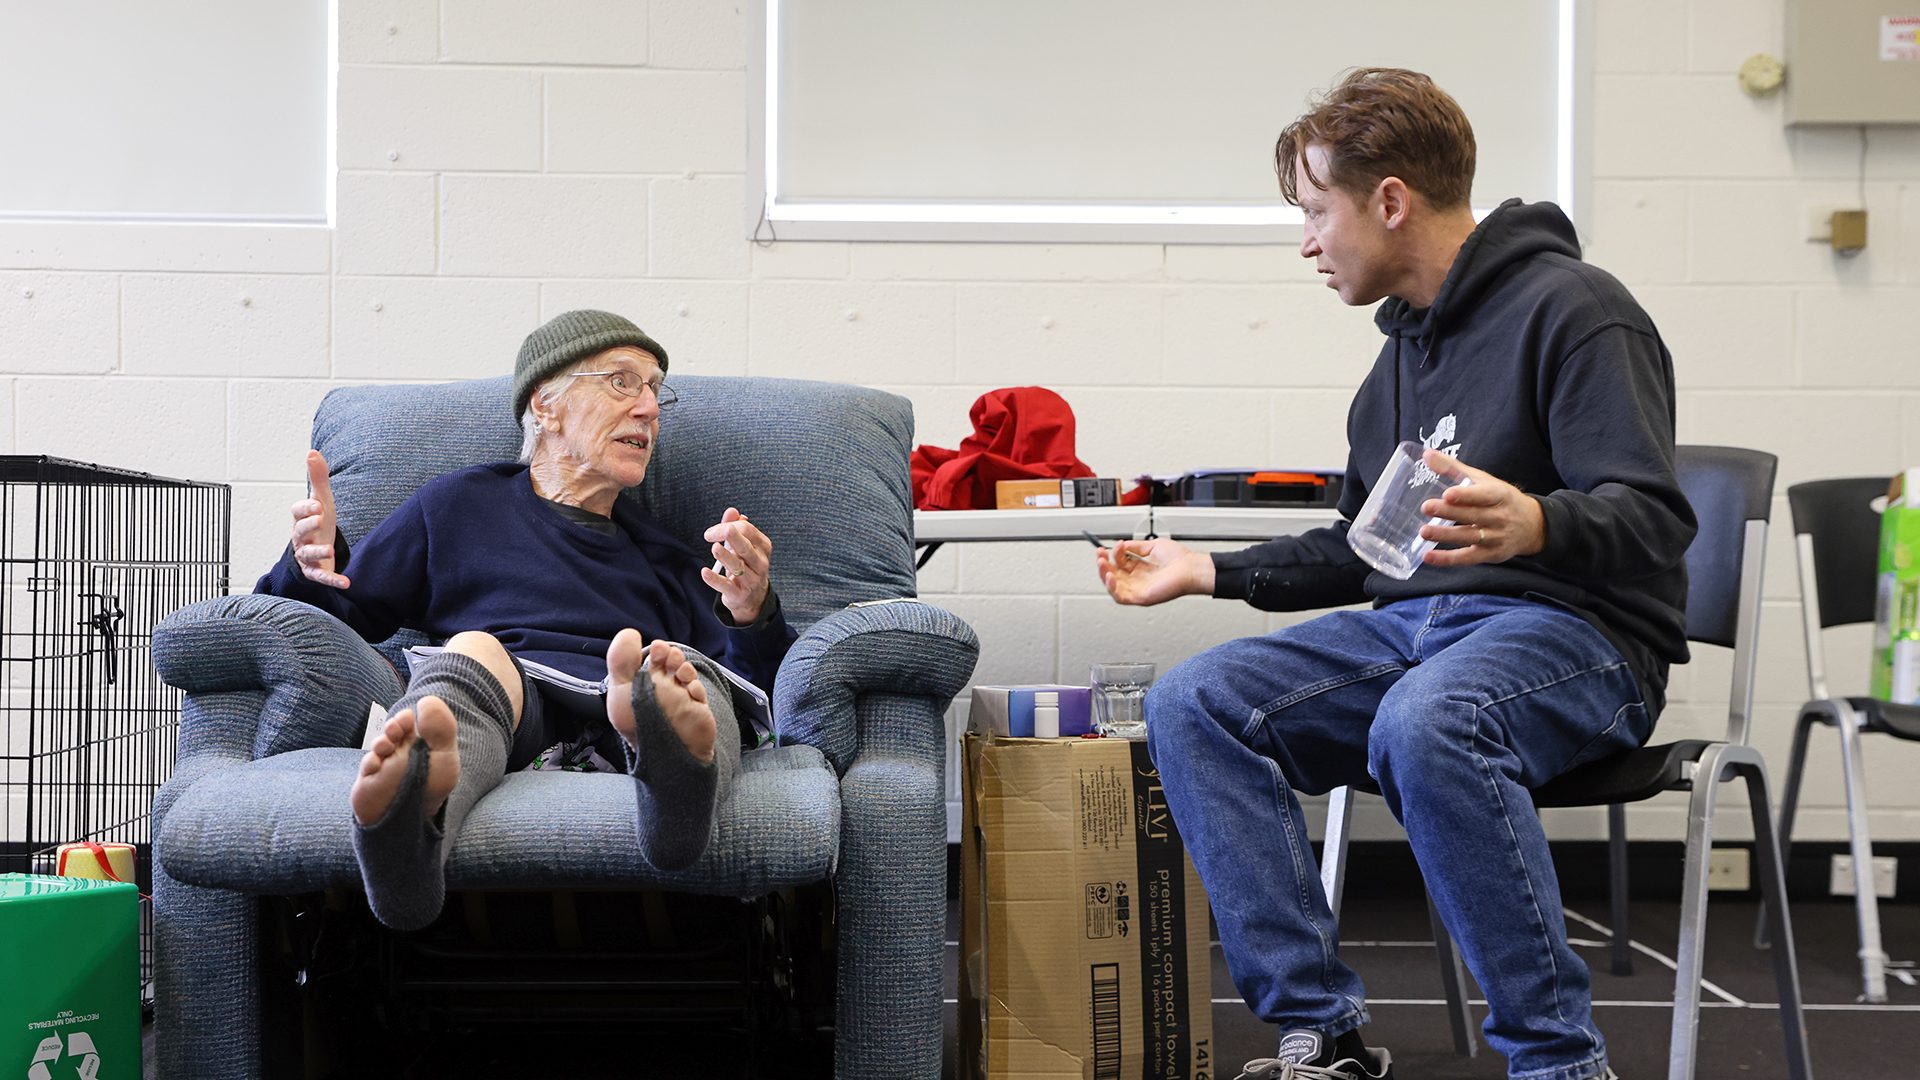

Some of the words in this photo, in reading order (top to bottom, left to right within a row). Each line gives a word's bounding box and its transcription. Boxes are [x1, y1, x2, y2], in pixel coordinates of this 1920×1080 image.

[1149, 880, 1158, 898] 150
[1158, 869, 1174, 946] premium
[1150, 902, 1159, 932] sheets
[1152, 974, 1161, 985] 16
[1163, 953, 1178, 1027] compact
[1152, 989, 1162, 1018] packs
[57, 1010, 73, 1018] ONLY
[64, 1013, 100, 1024] RECYCLING
[28, 1018, 64, 1030] MATERIALS
[1153, 1022, 1161, 1038] per
[41, 1044, 61, 1052] REDUCE
[1154, 1042, 1162, 1074] carton
